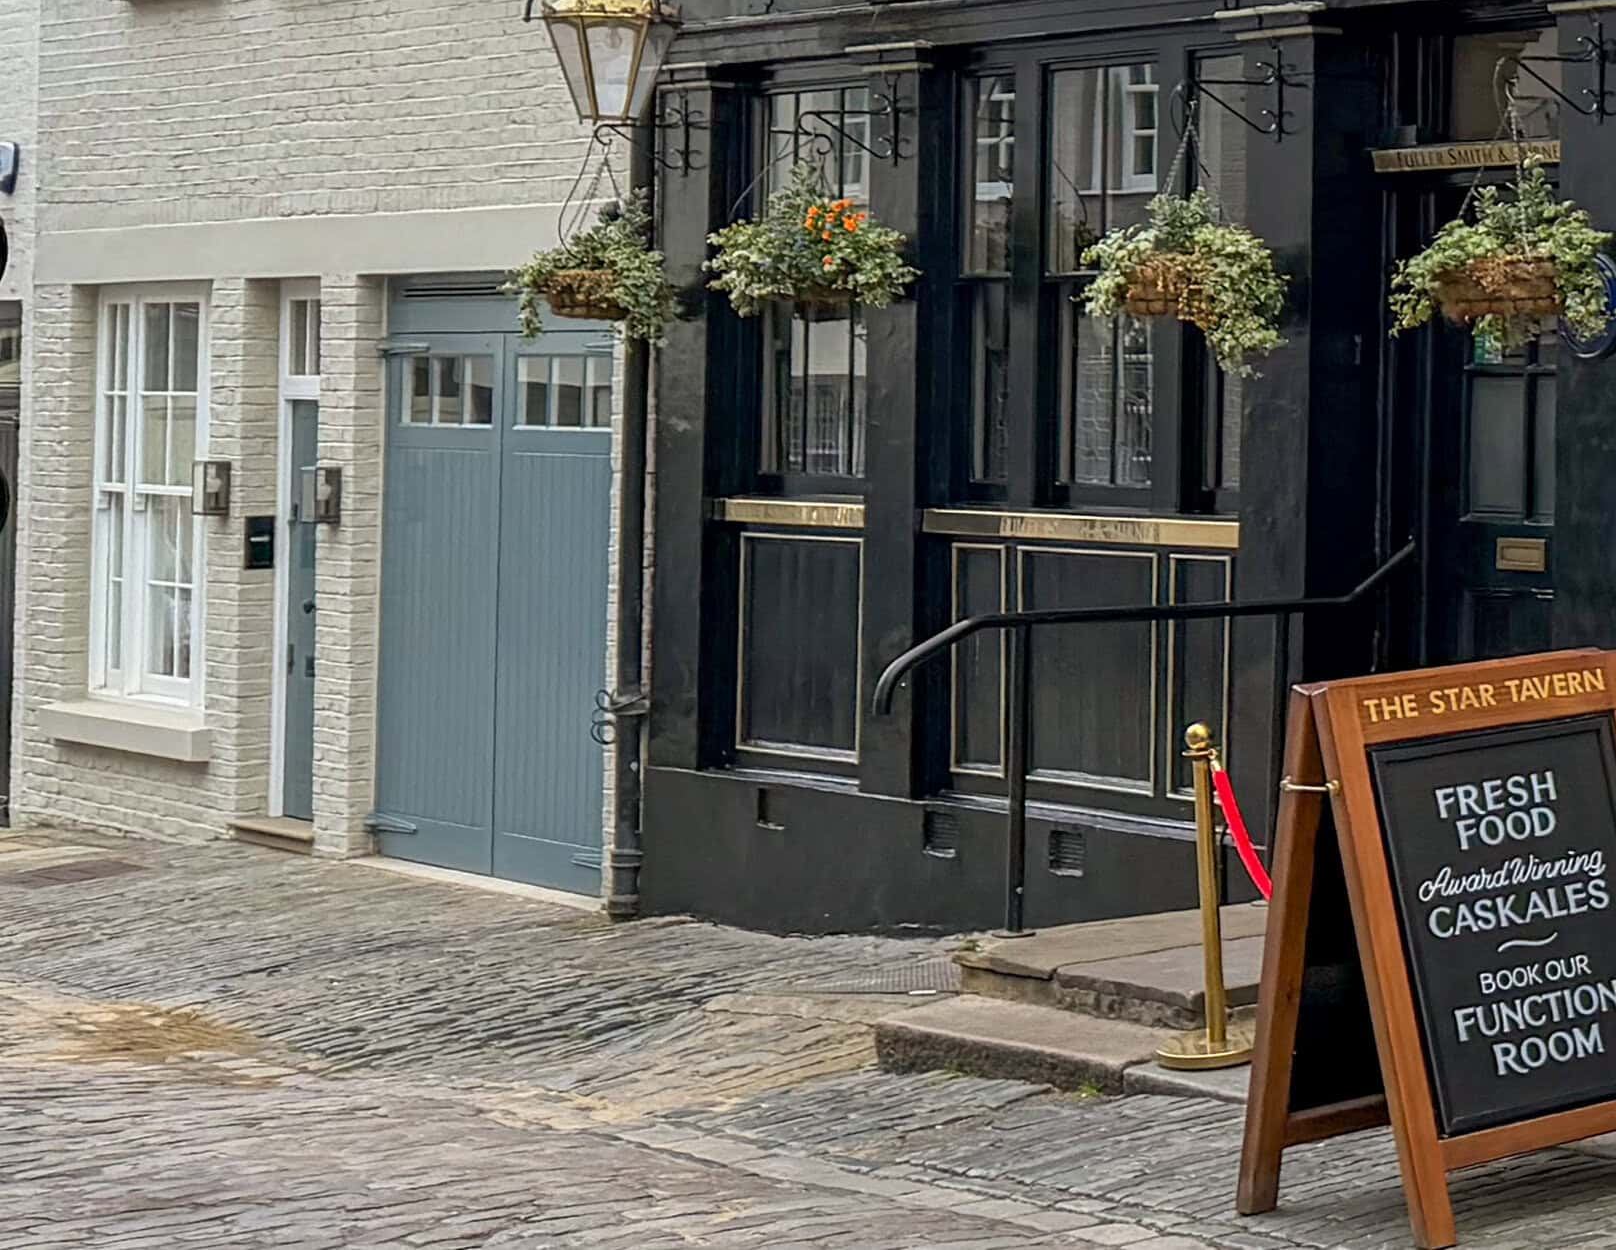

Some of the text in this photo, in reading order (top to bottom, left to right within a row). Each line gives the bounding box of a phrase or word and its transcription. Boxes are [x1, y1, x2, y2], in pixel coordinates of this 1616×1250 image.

[1447, 148, 1492, 166] SMITH
[1364, 668, 1606, 723] THE STAR TAVERN
[1435, 770, 1558, 819] FRESH
[1455, 806, 1557, 851] FOOD
[1418, 849, 1608, 902] Award Winning
[1428, 879, 1611, 940] CASK ALES
[1480, 954, 1592, 995] BOOK OUR
[1492, 1023, 1605, 1077] ROOM
